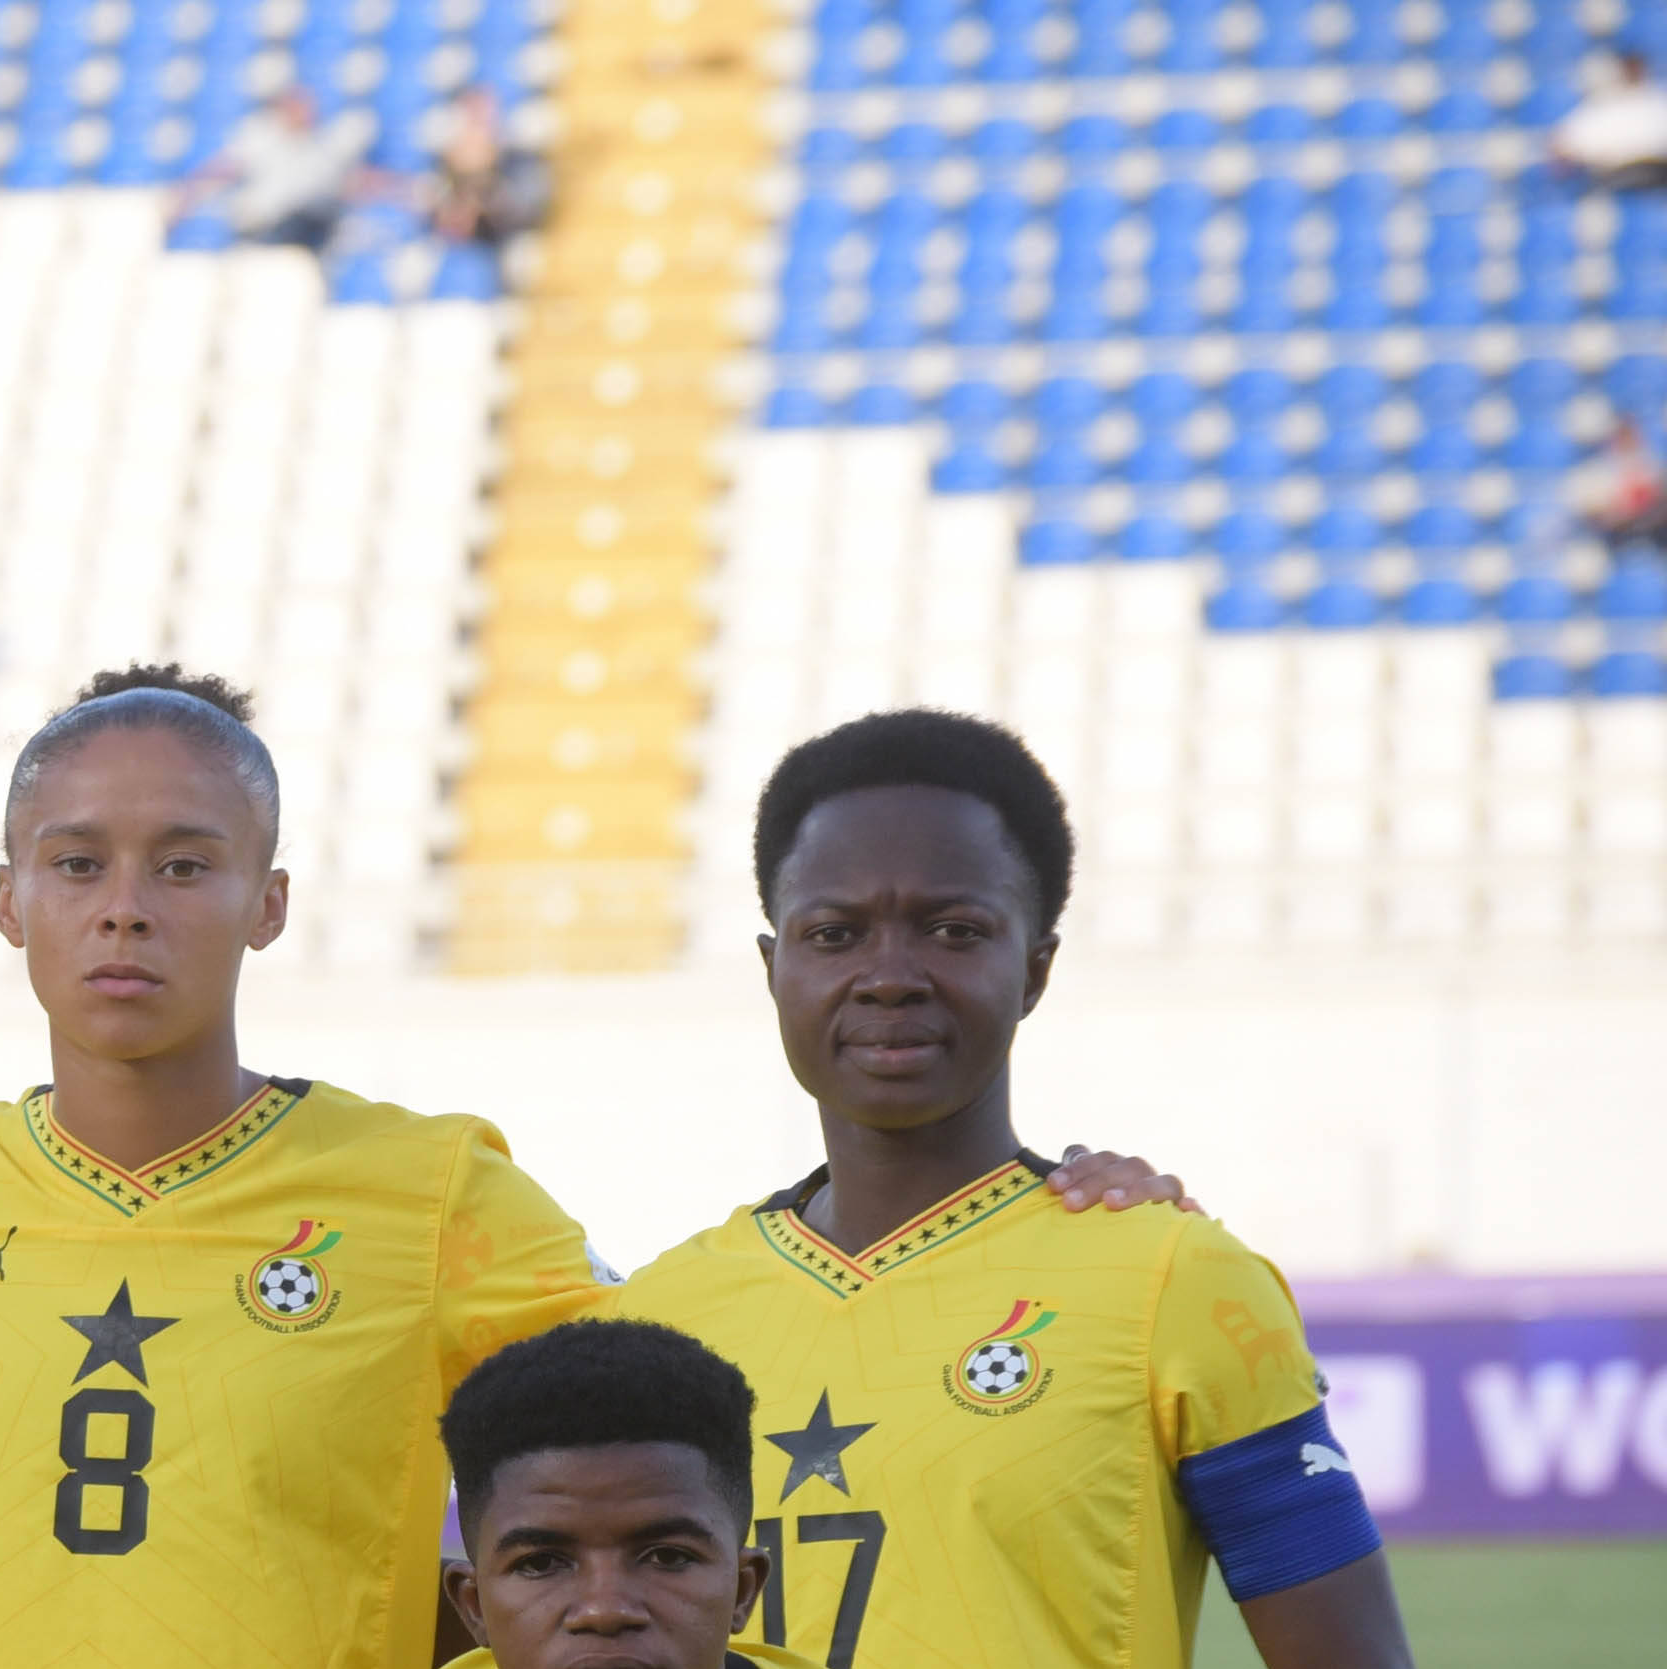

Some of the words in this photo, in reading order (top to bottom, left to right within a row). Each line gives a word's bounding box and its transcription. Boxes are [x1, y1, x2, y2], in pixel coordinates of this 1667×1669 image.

[234, 1273, 247, 1307] GHANA
[244, 1305, 291, 1334] FOOTBALL
[294, 1289, 342, 1334] ASSOCIATION
[942, 1363, 955, 1396] GHANA
[951, 1393, 1002, 1416] FOOTBALL
[1003, 1367, 1055, 1416] ASSOCIATION
[53, 1388, 155, 1555] 8
